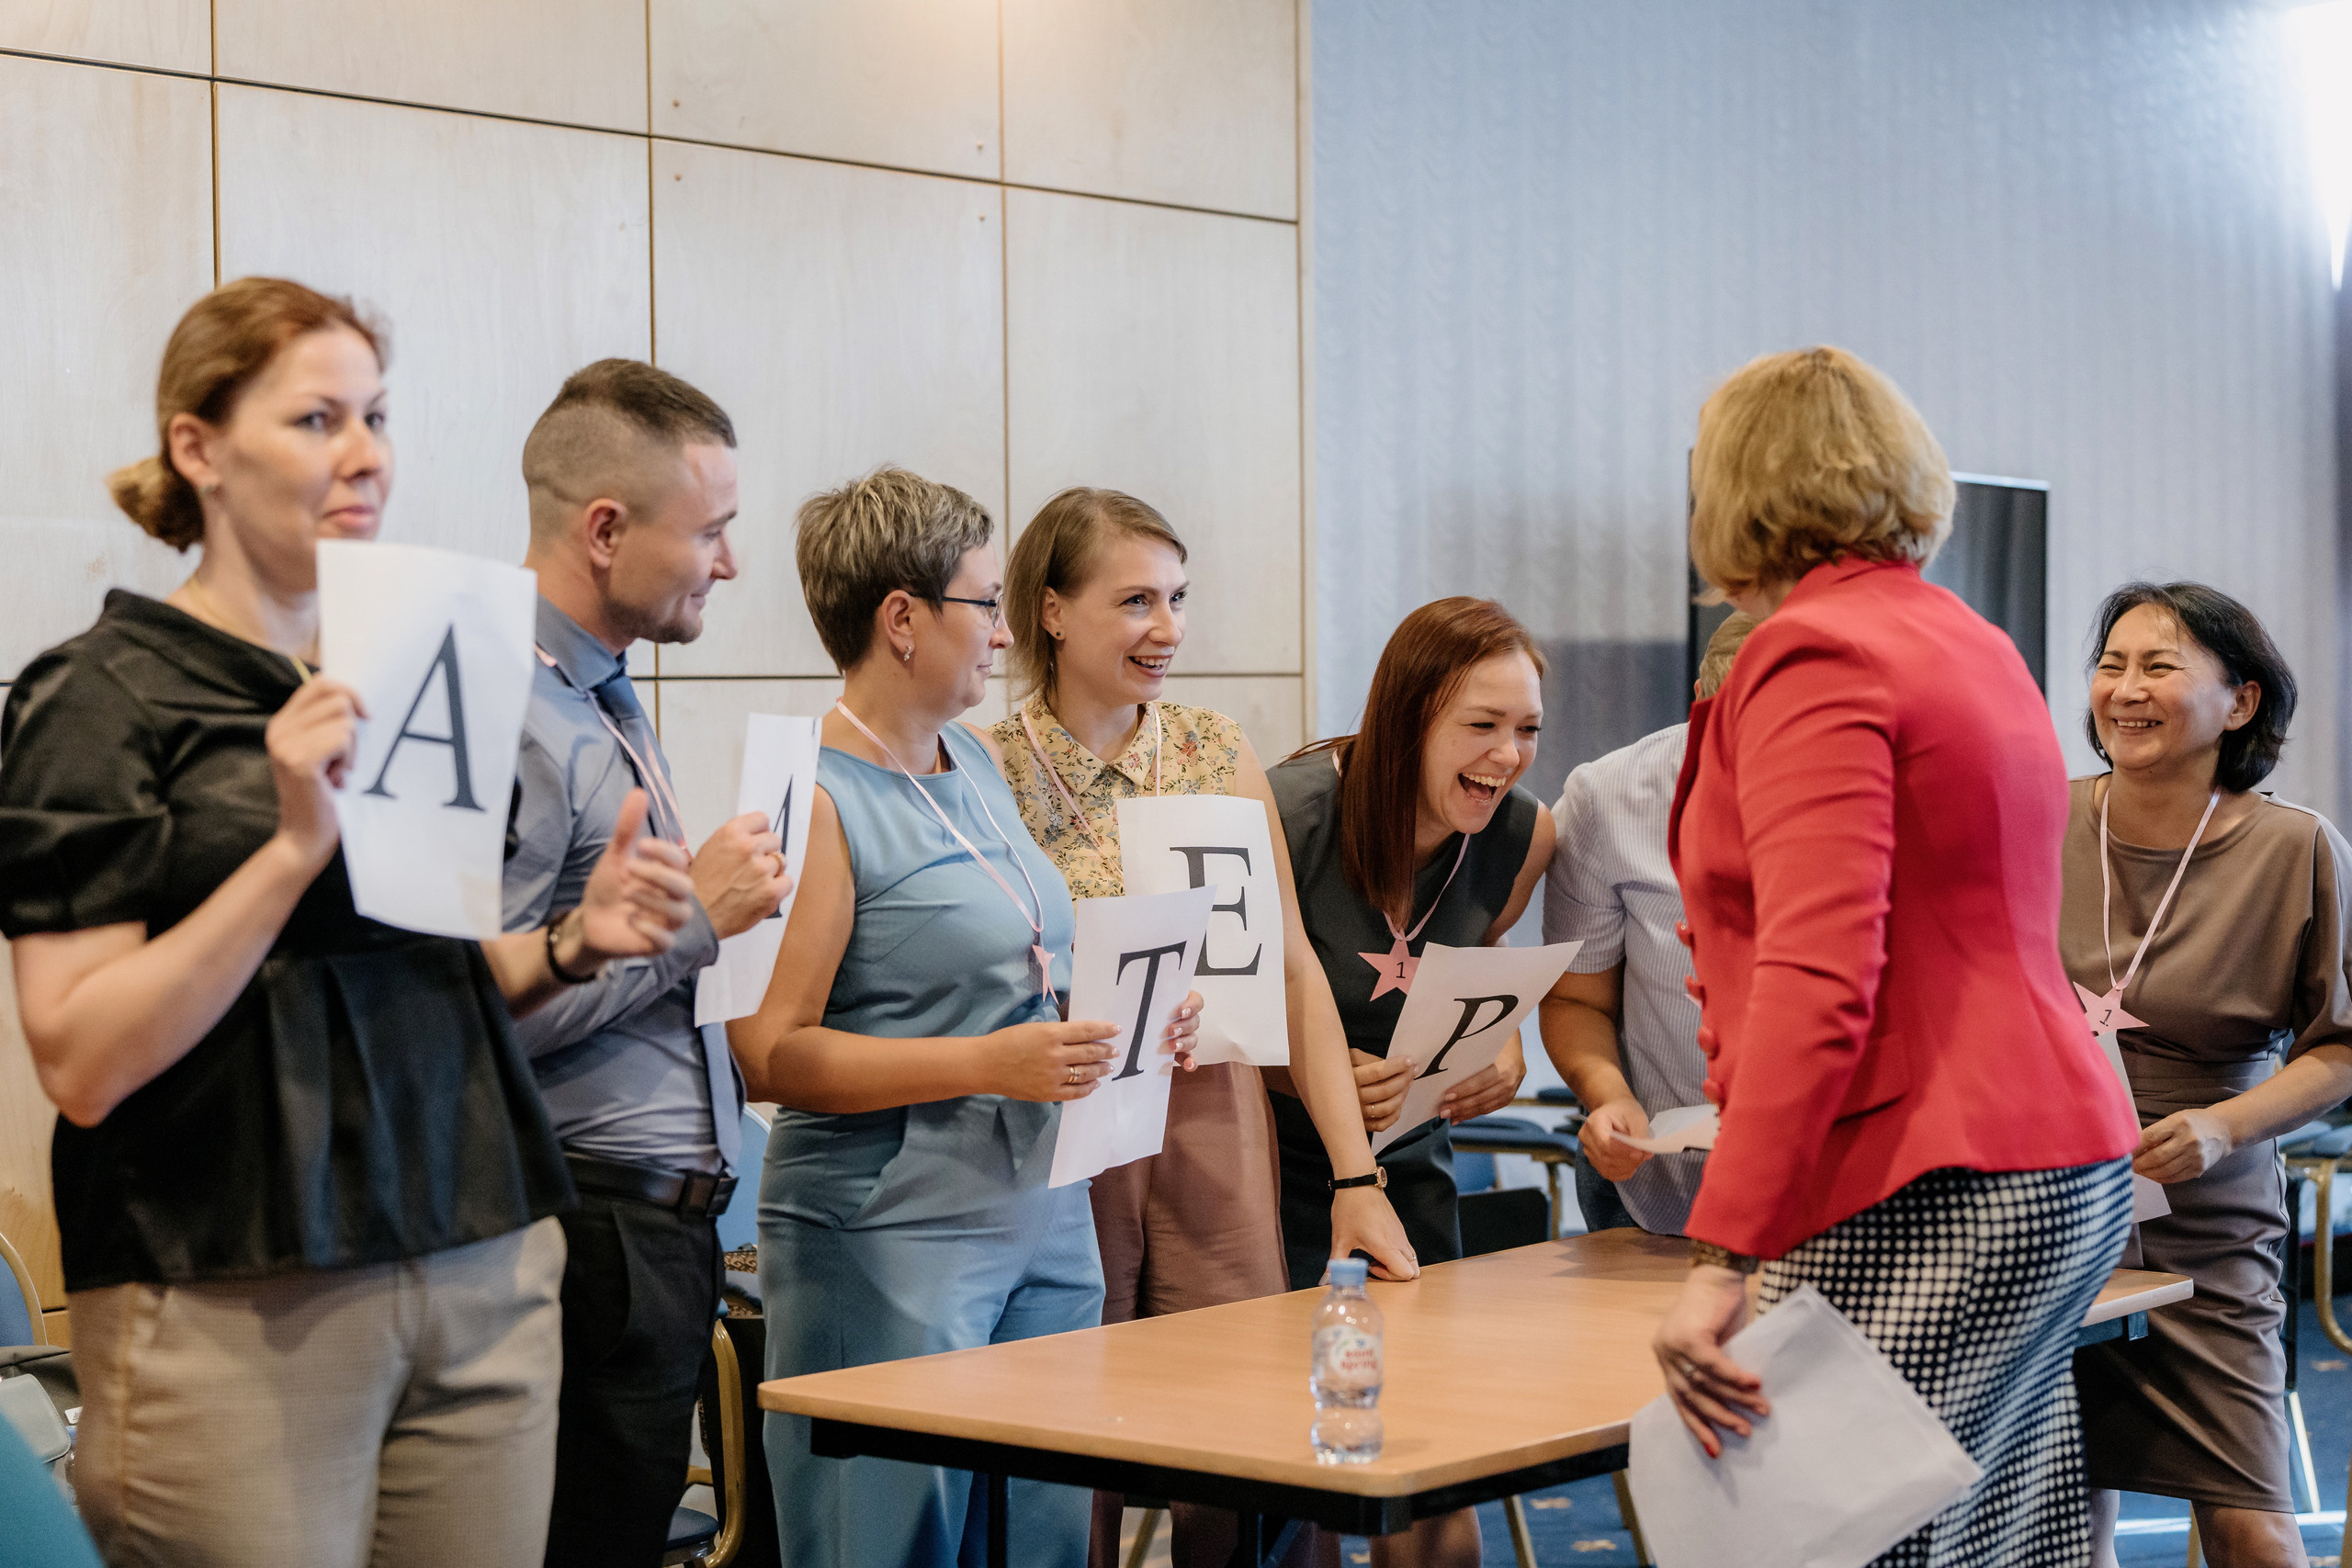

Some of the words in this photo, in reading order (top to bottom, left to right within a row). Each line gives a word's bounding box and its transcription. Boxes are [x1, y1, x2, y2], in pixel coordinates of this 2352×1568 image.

[362, 625, 486, 812] A
[1170, 846, 1262, 976] E
[1112, 941, 1187, 1081] T
[1395, 961, 1407, 979] 1
[2099, 1009, 2112, 1027] 1
[1413, 994, 1519, 1080] P
